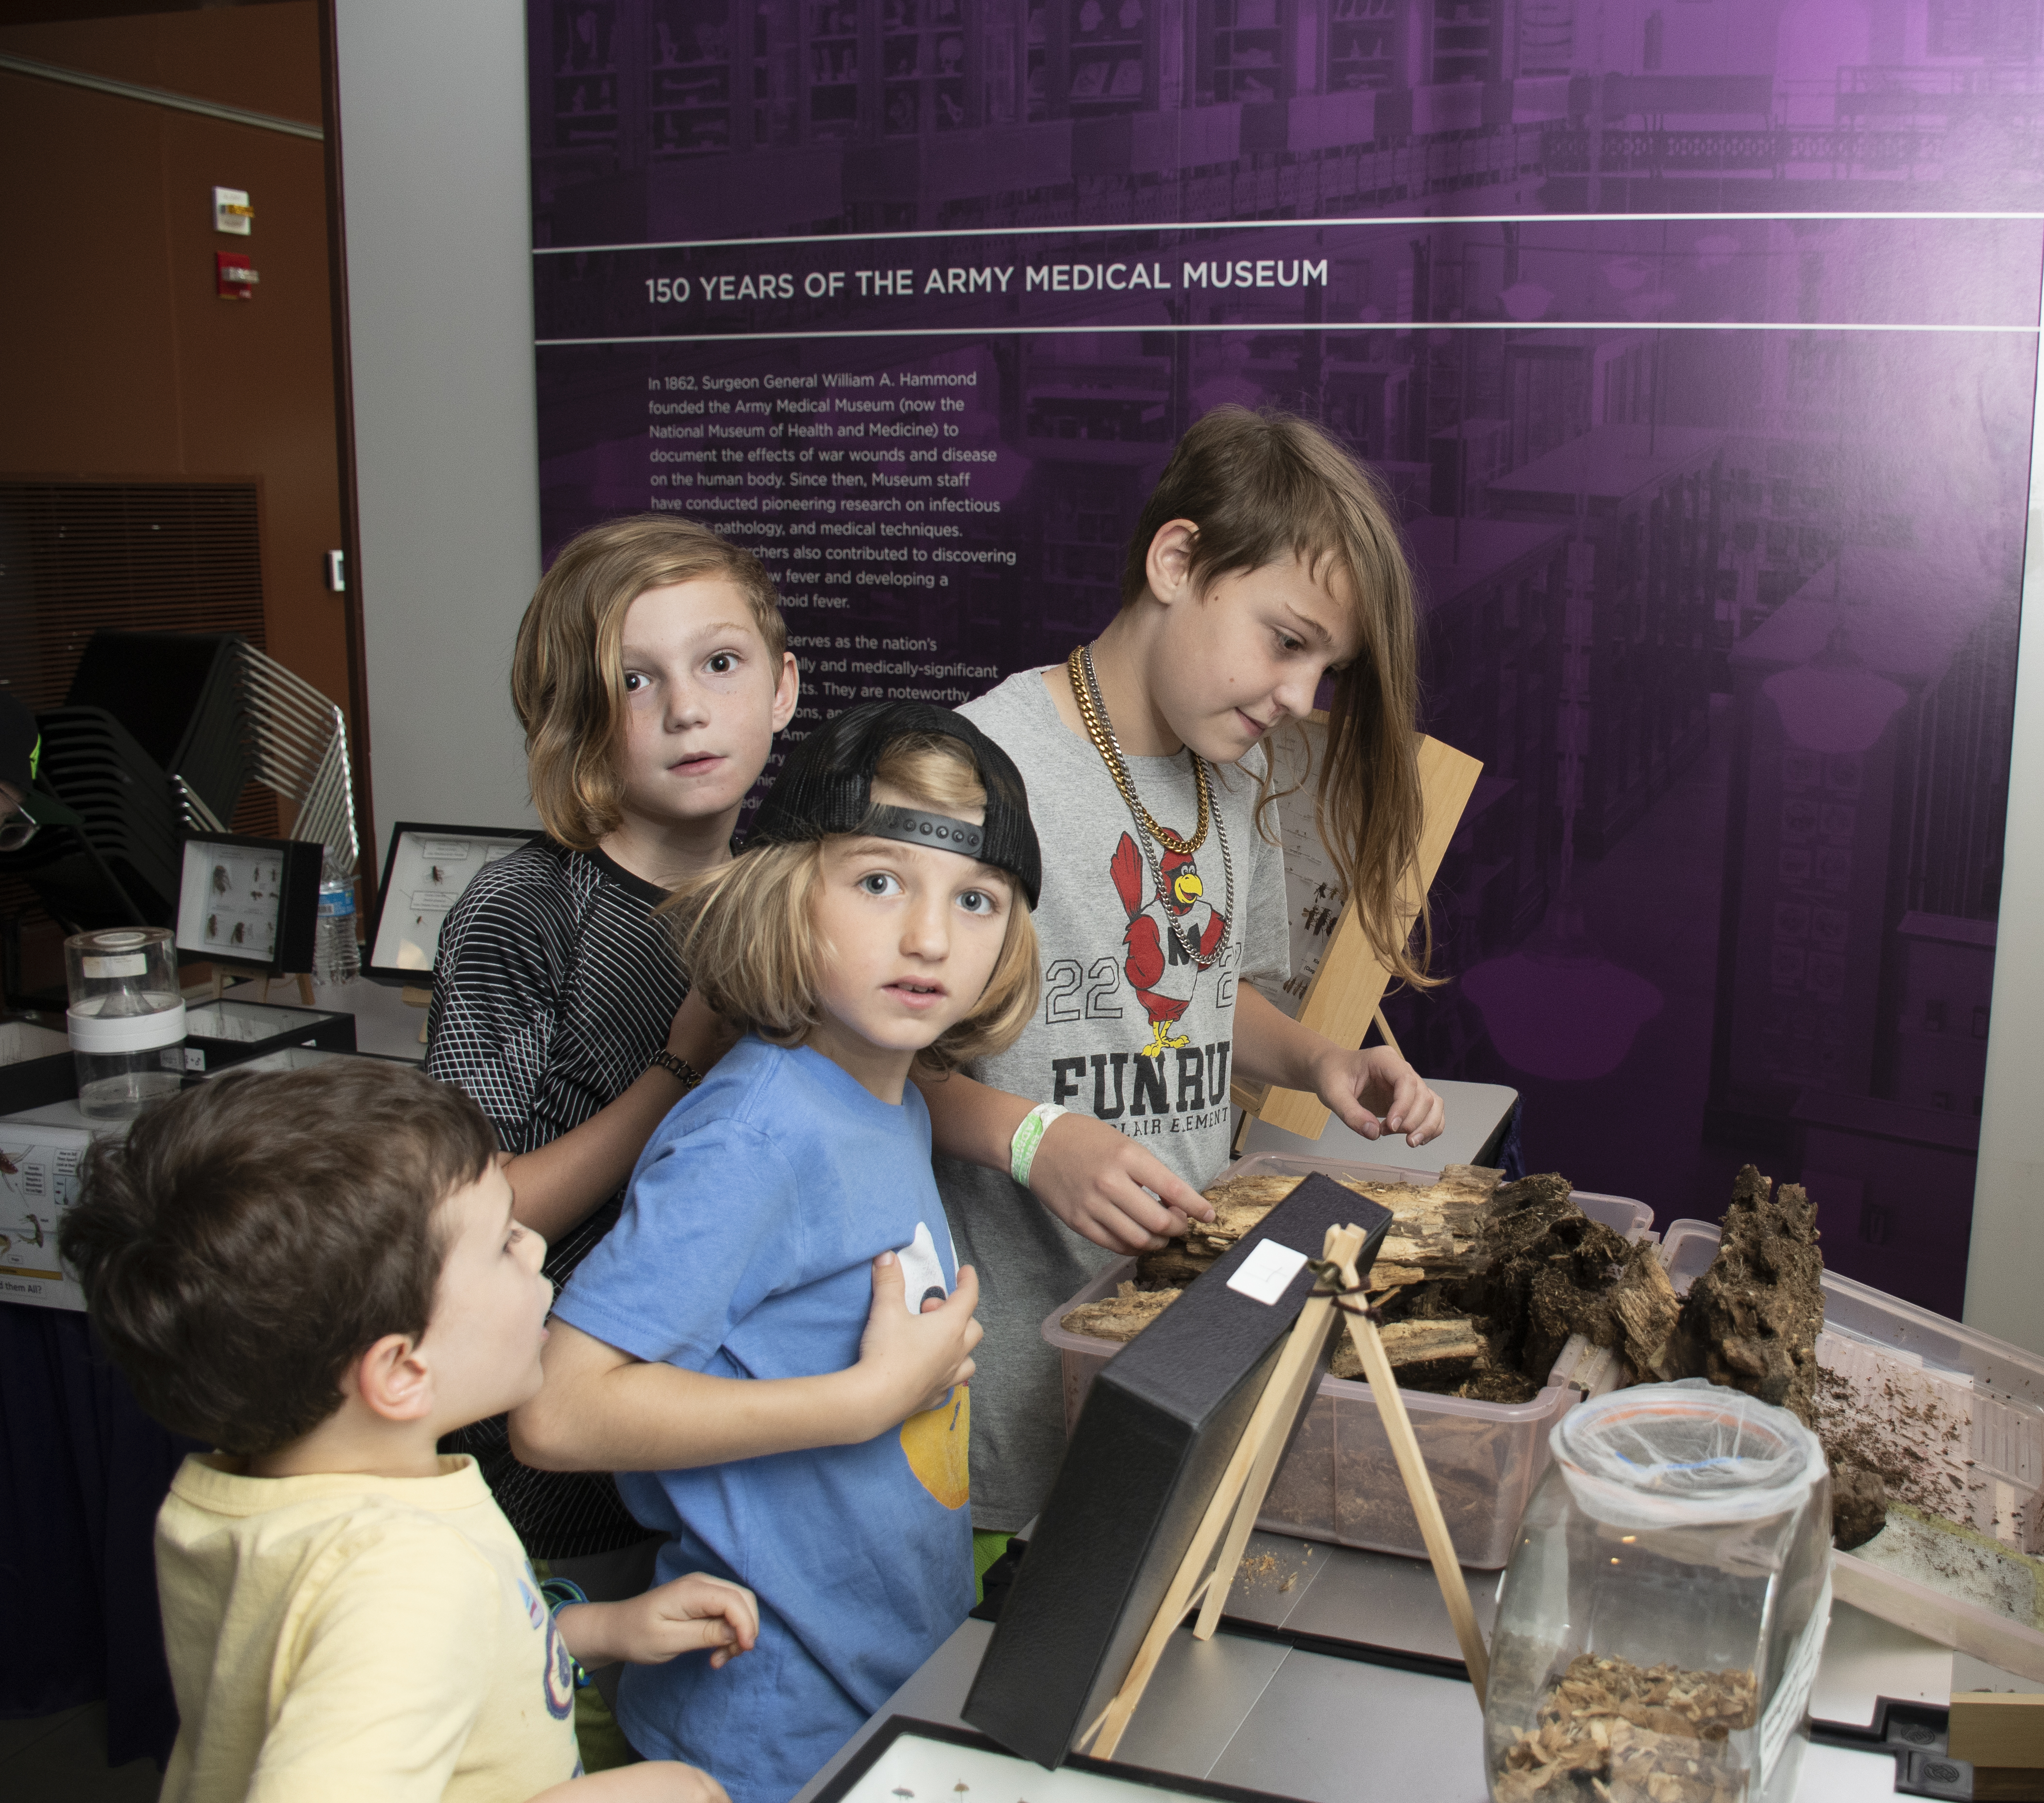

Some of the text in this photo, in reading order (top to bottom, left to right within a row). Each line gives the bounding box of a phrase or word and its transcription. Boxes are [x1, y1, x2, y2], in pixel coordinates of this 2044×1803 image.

[645, 259, 1328, 303] 150 YEARS OF THE ARMY MEDICAL MUSEUM
[648, 371, 977, 392] In 1862, Surgeon General William A. Hammond
[648, 397, 965, 416] founded the Army Medical Museum (now the
[649, 422, 959, 439] National Museum of Health and Medicine) to
[649, 447, 997, 462] document the effects of war wounds and disease
[650, 472, 971, 489] on the human body. Since then, Museum staff
[651, 496, 1001, 513] have conducted pioneering research on infectious
[714, 520, 785, 538] pathology,
[789, 521, 816, 535] and
[820, 521, 876, 536] medical
[880, 522, 963, 539] techniques.
[793, 545, 822, 560] also
[825, 546, 908, 561] contributed
[912, 548, 928, 561] to
[932, 547, 1016, 566] discovering
[786, 568, 820, 583] fever
[825, 570, 851, 584] and
[856, 571, 935, 589] developing
[939, 575, 948, 586] a
[812, 593, 849, 609] fever.
[787, 635, 831, 648] serves
[835, 637, 851, 648] as
[855, 635, 878, 649] the
[820, 658, 847, 672] and
[851, 660, 998, 679] medically-significant
[823, 681, 857, 699] They
[861, 686, 883, 698] are
[888, 686, 969, 702] noteworthy
[827, 706, 843, 719] an
[1046, 956, 1123, 1024] 22
[1052, 1052, 1169, 1120] FUN
[5, 1282, 26, 1292] them
[28, 1285, 42, 1293] All?
